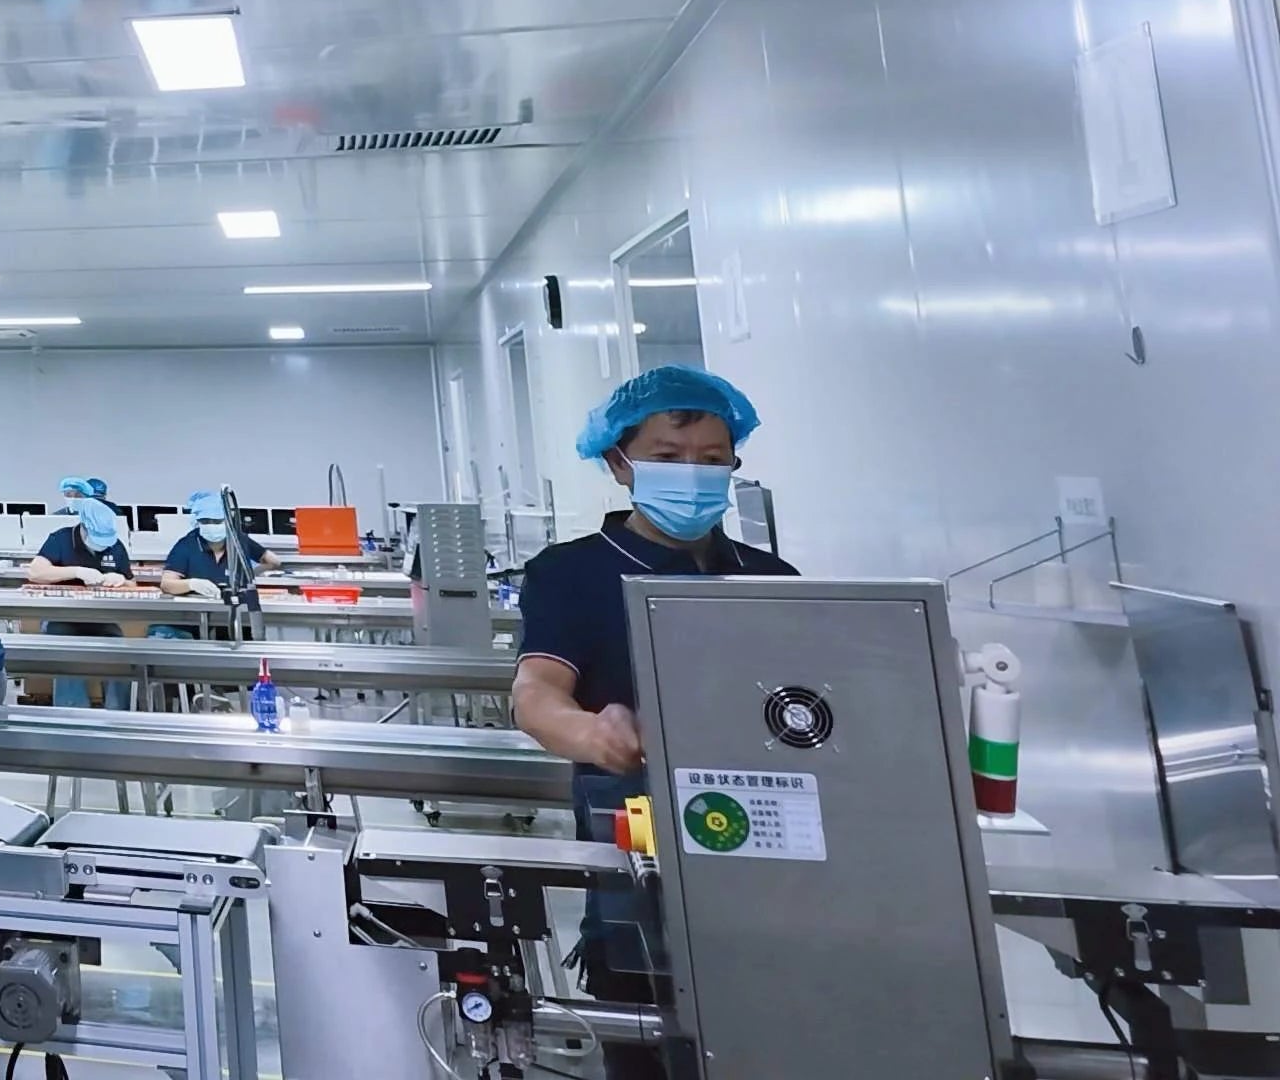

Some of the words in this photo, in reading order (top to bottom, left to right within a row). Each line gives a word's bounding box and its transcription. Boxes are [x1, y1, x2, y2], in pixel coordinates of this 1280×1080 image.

[689, 772, 804, 789] 设备状态管理标识
